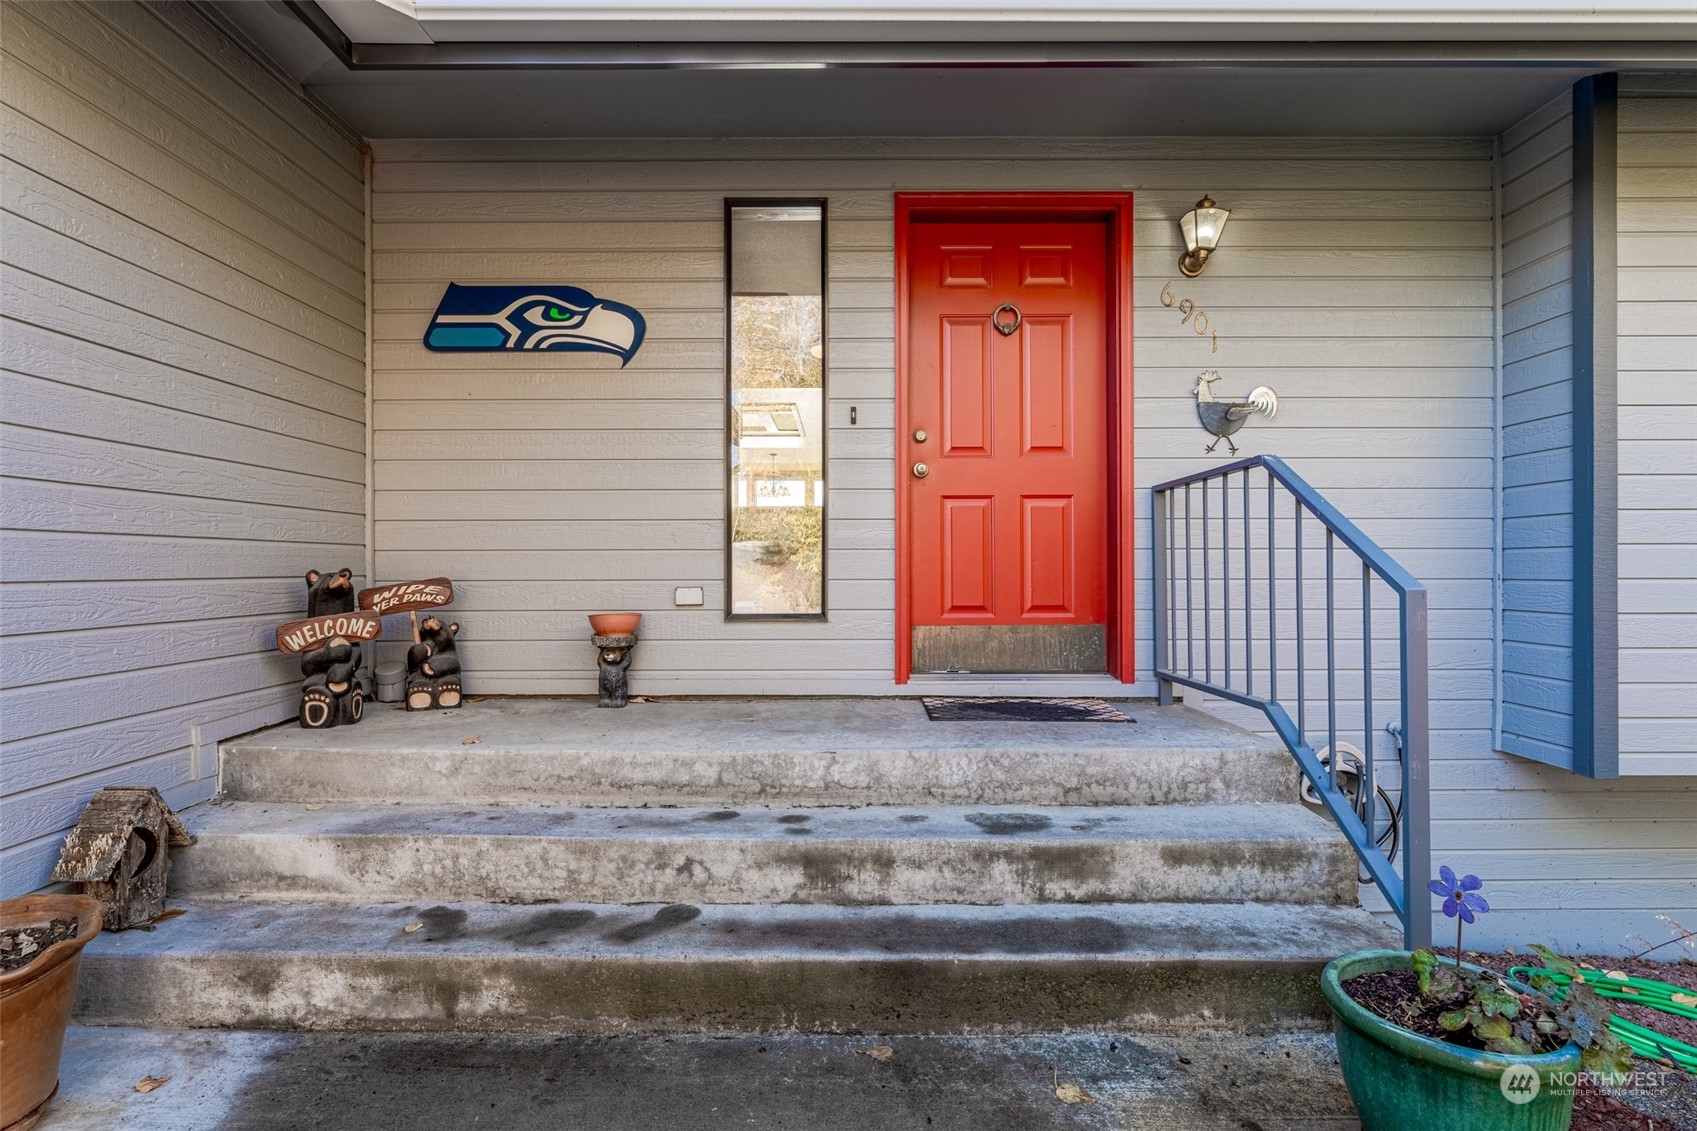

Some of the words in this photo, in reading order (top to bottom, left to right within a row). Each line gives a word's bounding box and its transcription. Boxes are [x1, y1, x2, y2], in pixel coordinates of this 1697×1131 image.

[1160, 281, 1218, 353] 6901
[373, 584, 443, 603] WIPE
[402, 593, 445, 603] PAWS
[285, 617, 376, 651] WELCOME
